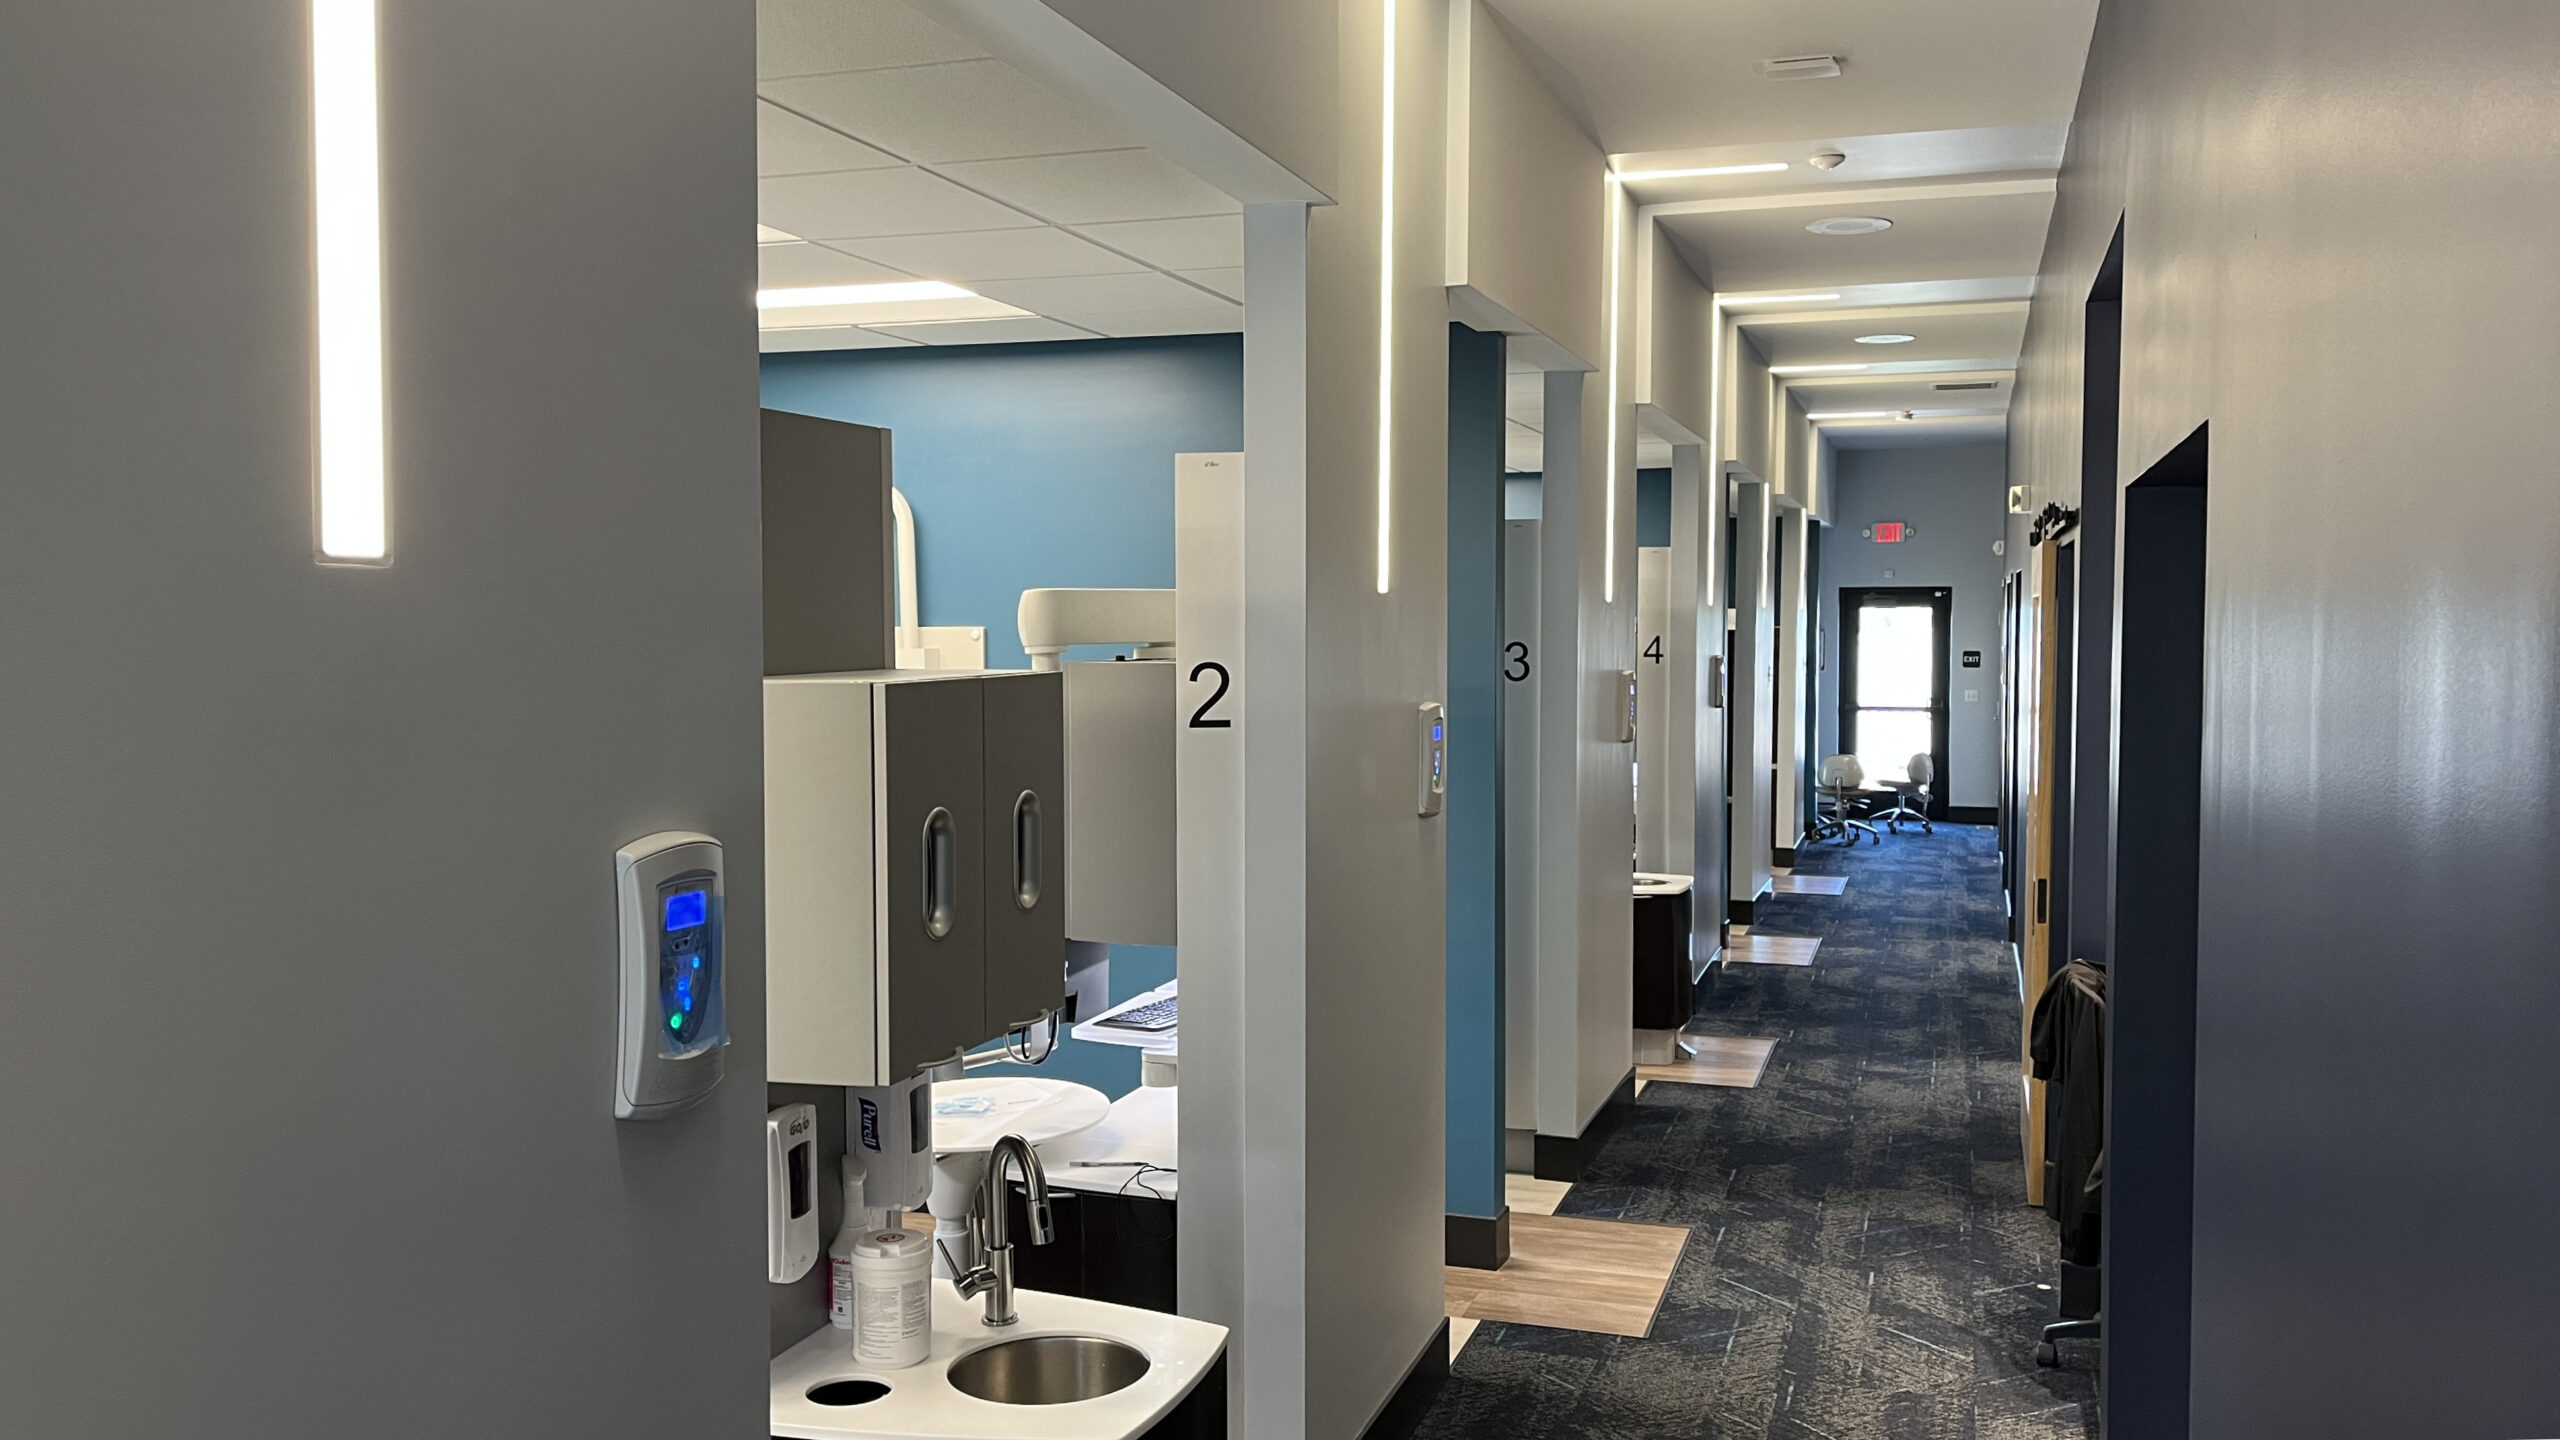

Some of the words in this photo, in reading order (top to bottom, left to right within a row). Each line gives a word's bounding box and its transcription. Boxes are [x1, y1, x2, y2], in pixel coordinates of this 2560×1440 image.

[1504, 641, 1530, 682] 3
[1643, 635, 1664, 664] 4
[1963, 655, 1980, 663] EXIT
[1189, 661, 1231, 728] 2
[863, 1104, 877, 1147] Purell
